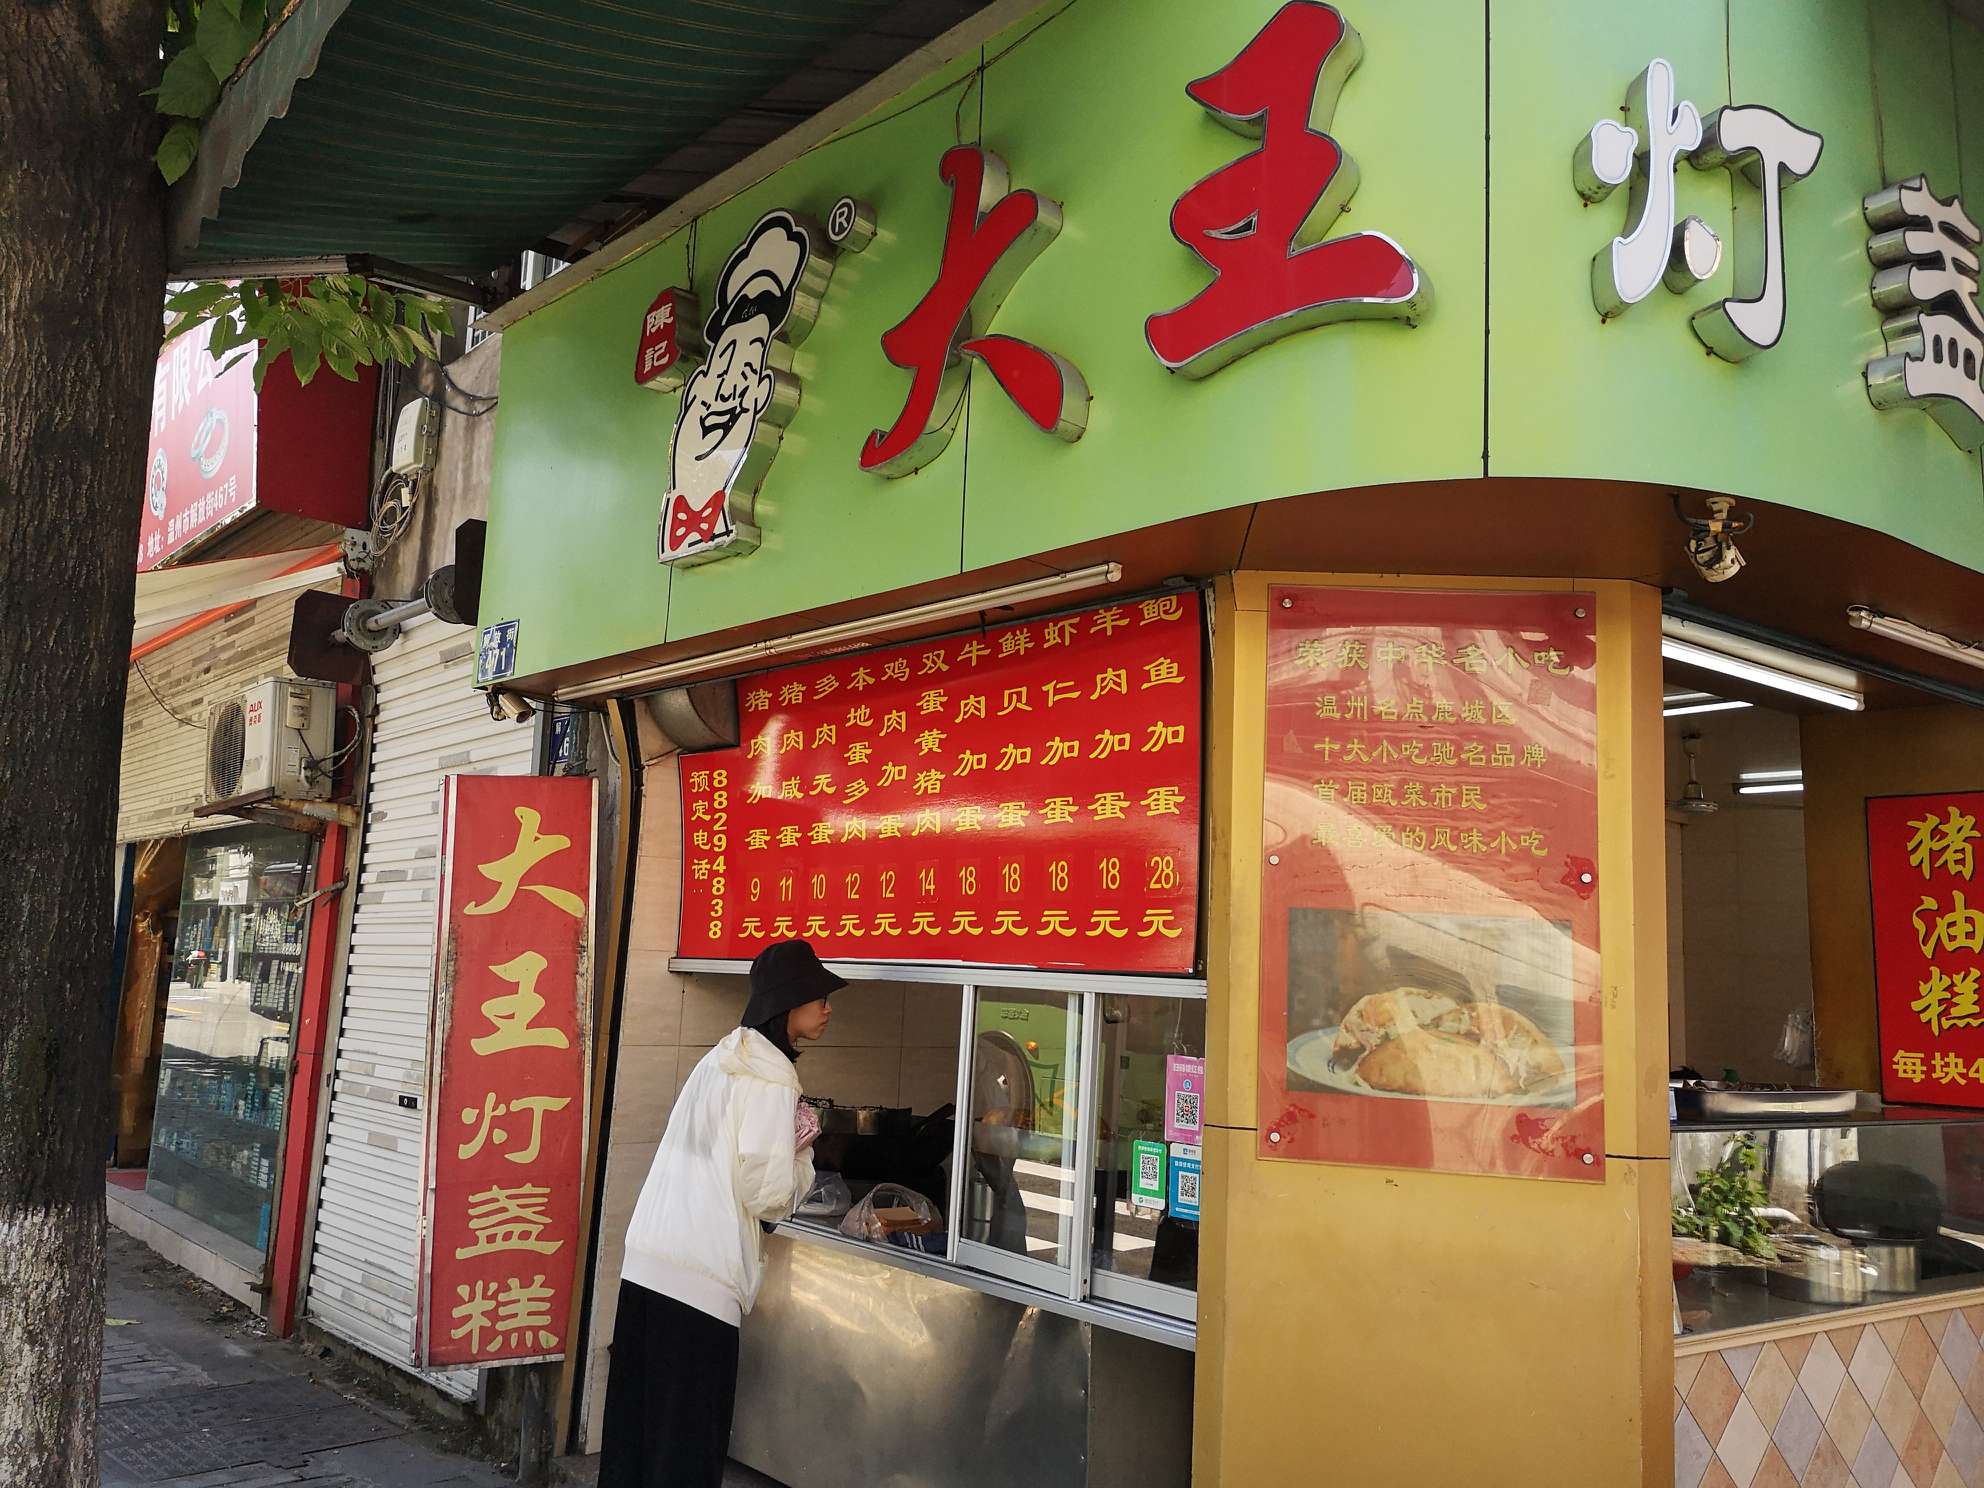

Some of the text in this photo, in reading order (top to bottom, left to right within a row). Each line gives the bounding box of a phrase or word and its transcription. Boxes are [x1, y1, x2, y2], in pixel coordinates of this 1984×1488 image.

[643, 303, 673, 374] 陳記
[1295, 639, 1571, 676] 荣获中华名小吃
[1314, 695, 1517, 726] 温州名点鹿城区
[1313, 737, 1547, 768] 十大小吃驰名品牌
[1313, 780, 1487, 810] 首届瓯菜市民
[708, 769, 728, 940] 88294838
[1906, 806, 1984, 1036] 猪油糕
[451, 806, 586, 1355] 大王灯盏糕
